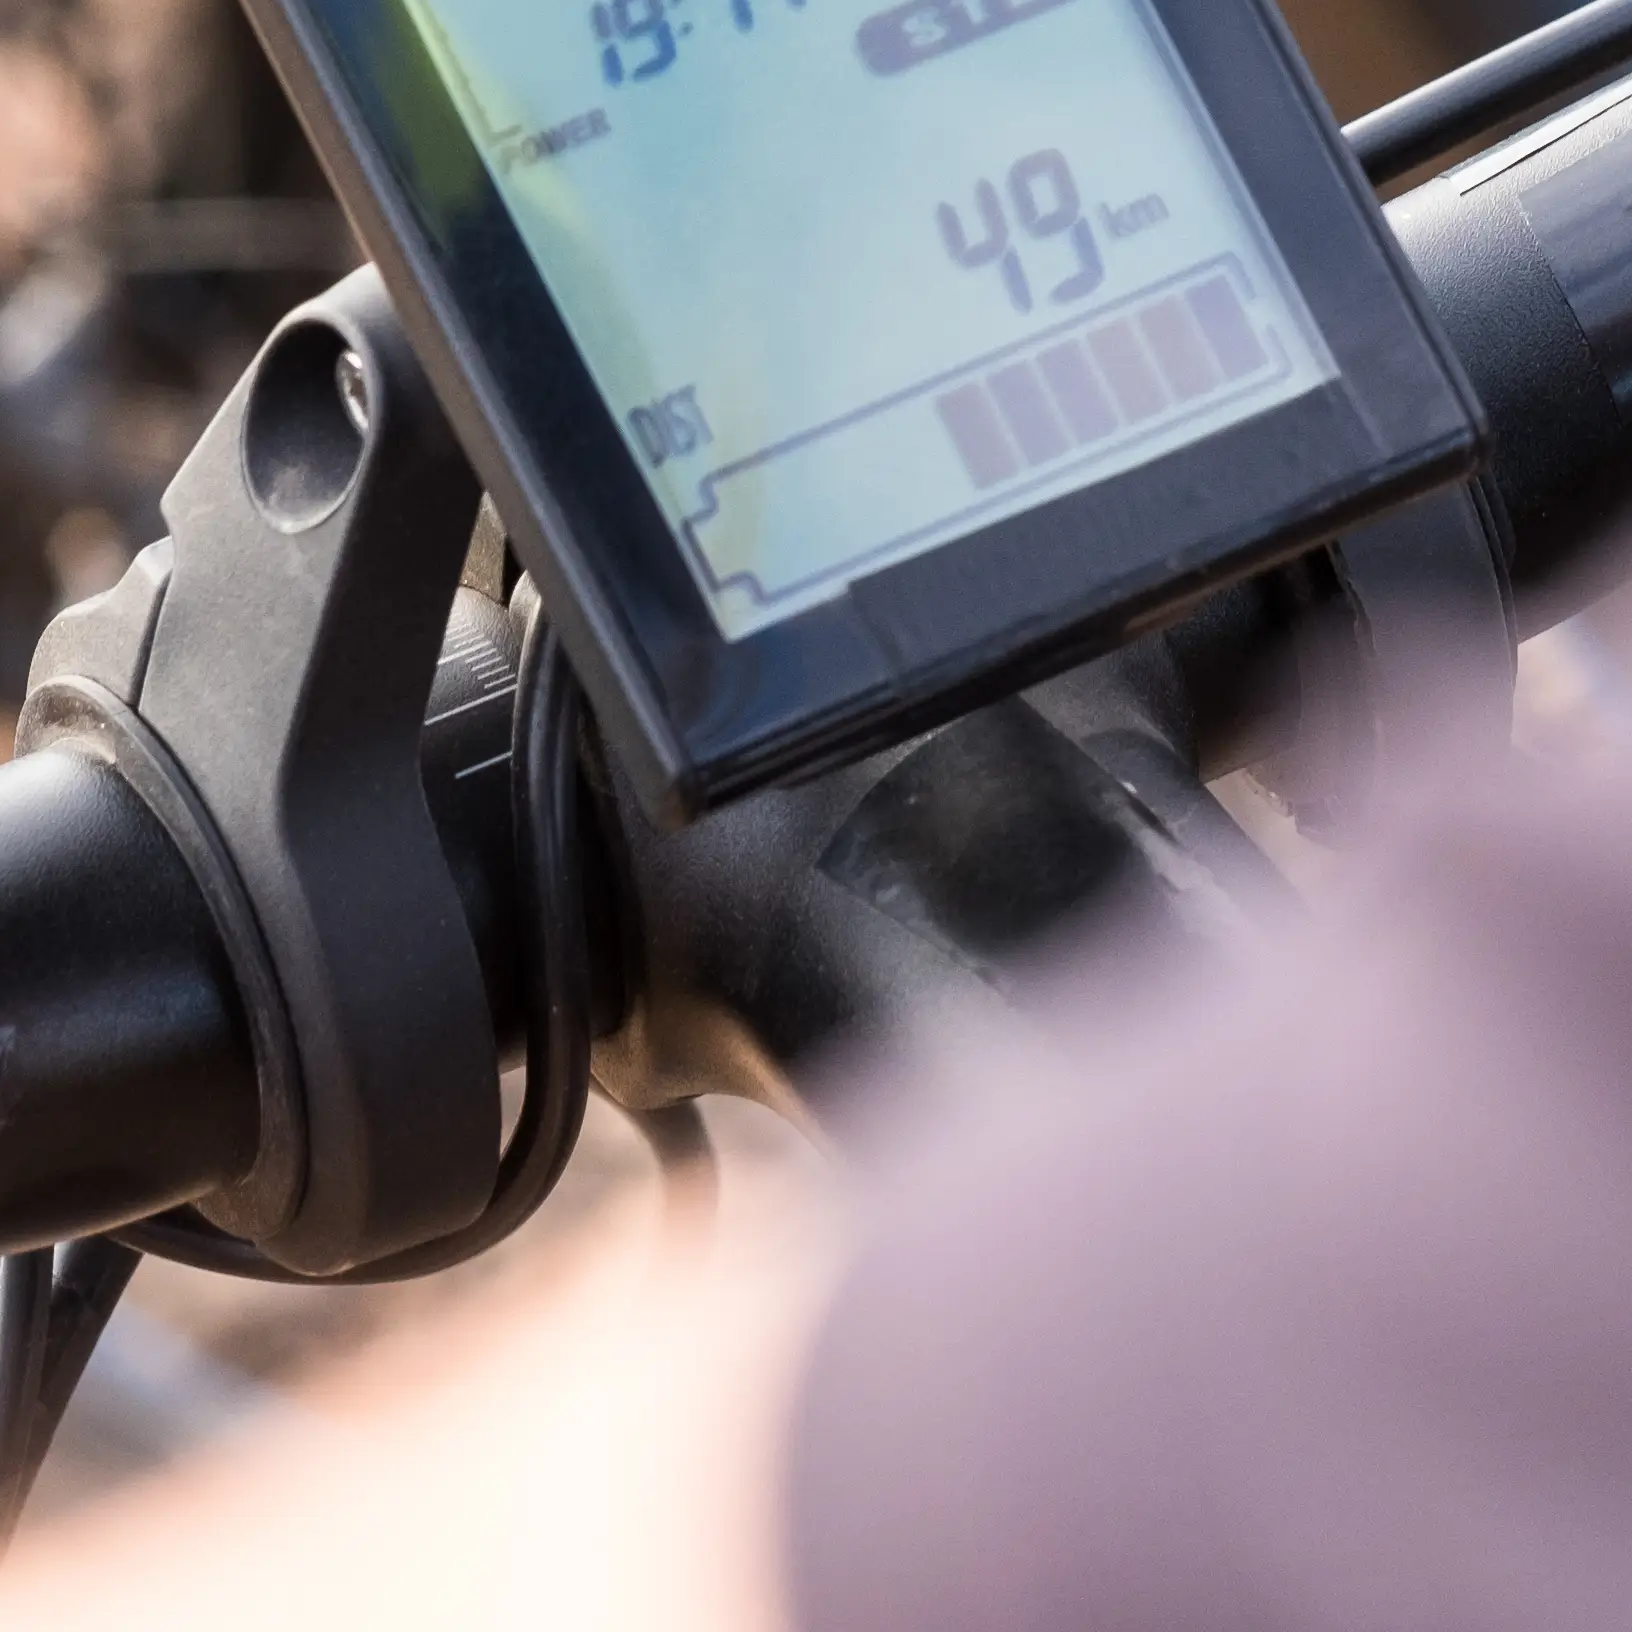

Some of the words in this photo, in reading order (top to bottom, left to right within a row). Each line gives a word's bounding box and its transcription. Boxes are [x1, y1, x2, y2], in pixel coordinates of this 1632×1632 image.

[499, 107, 612, 174] POWER
[935, 147, 1106, 316] 49
[1096, 192, 1170, 240] km
[627, 384, 714, 469] DIST
